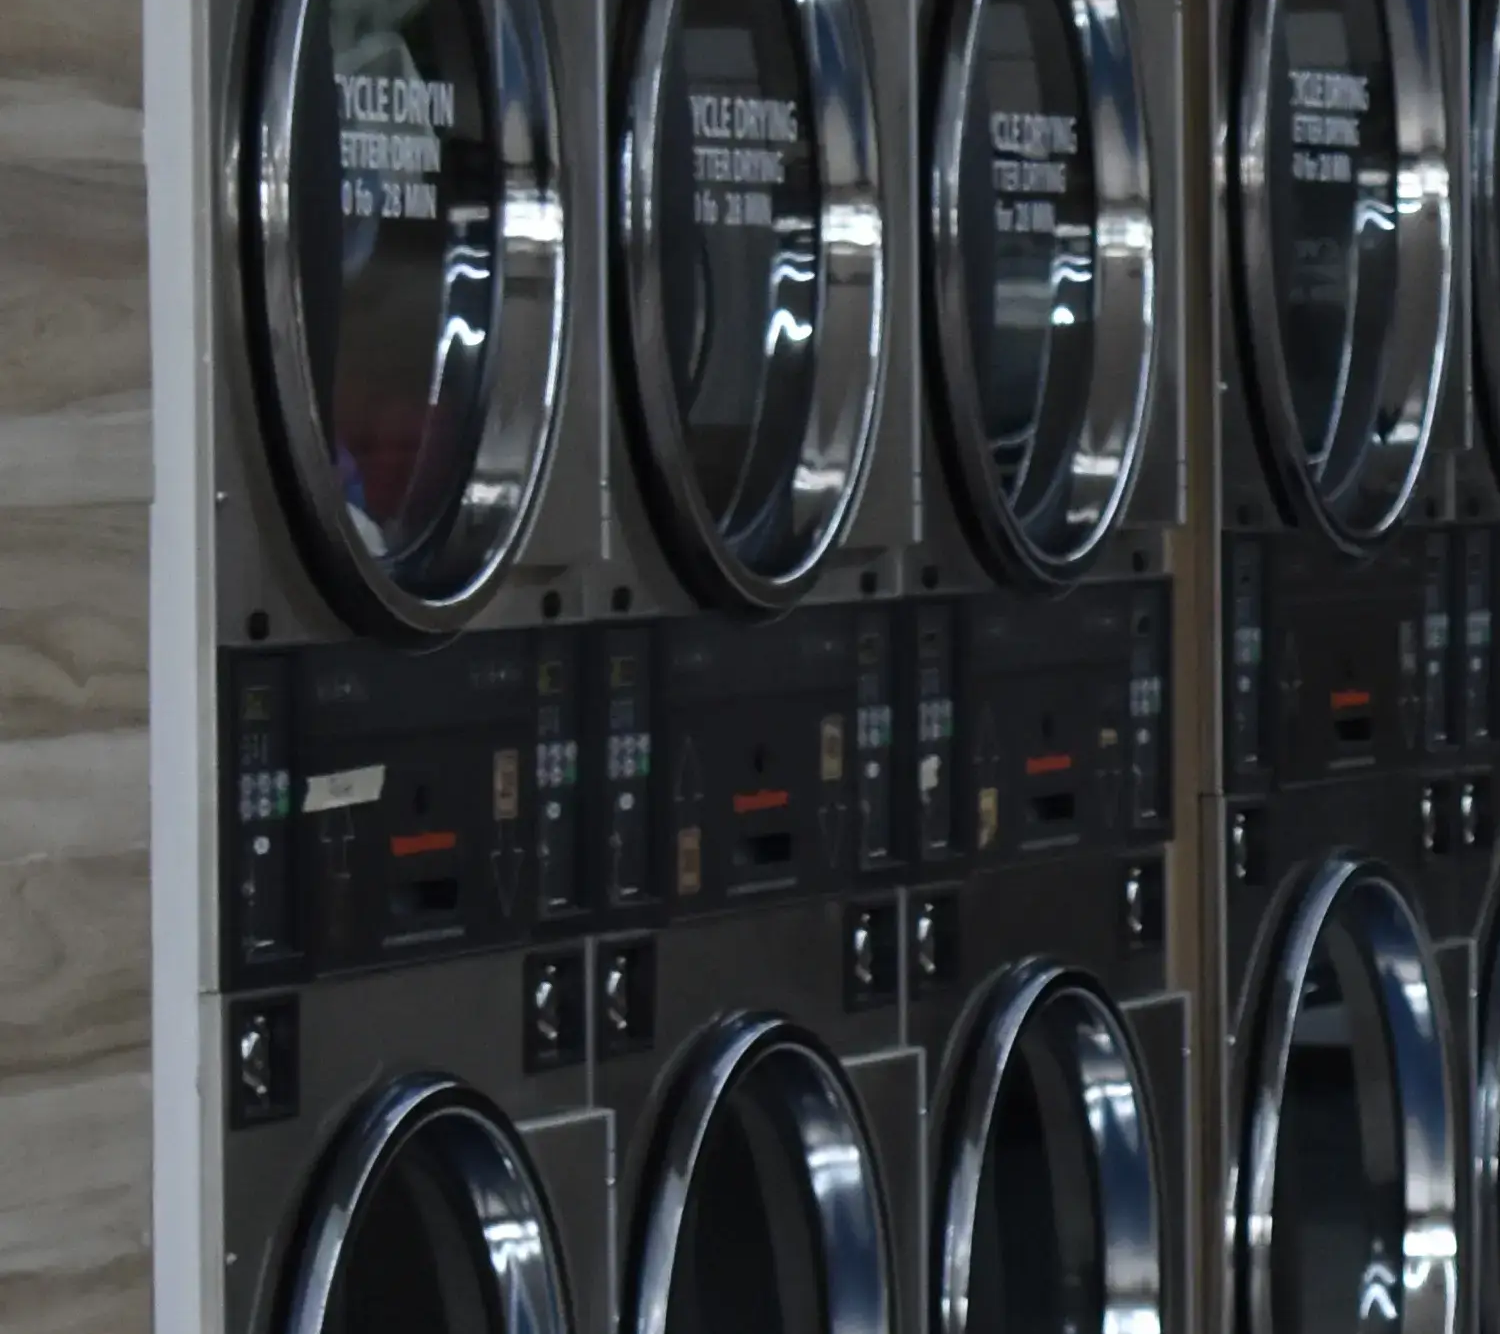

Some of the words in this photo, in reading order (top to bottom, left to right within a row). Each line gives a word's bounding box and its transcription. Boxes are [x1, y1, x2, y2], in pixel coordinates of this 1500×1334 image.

[334, 73, 390, 122] YCLE
[689, 94, 732, 139] YCLE
[340, 130, 388, 169] ETTER
